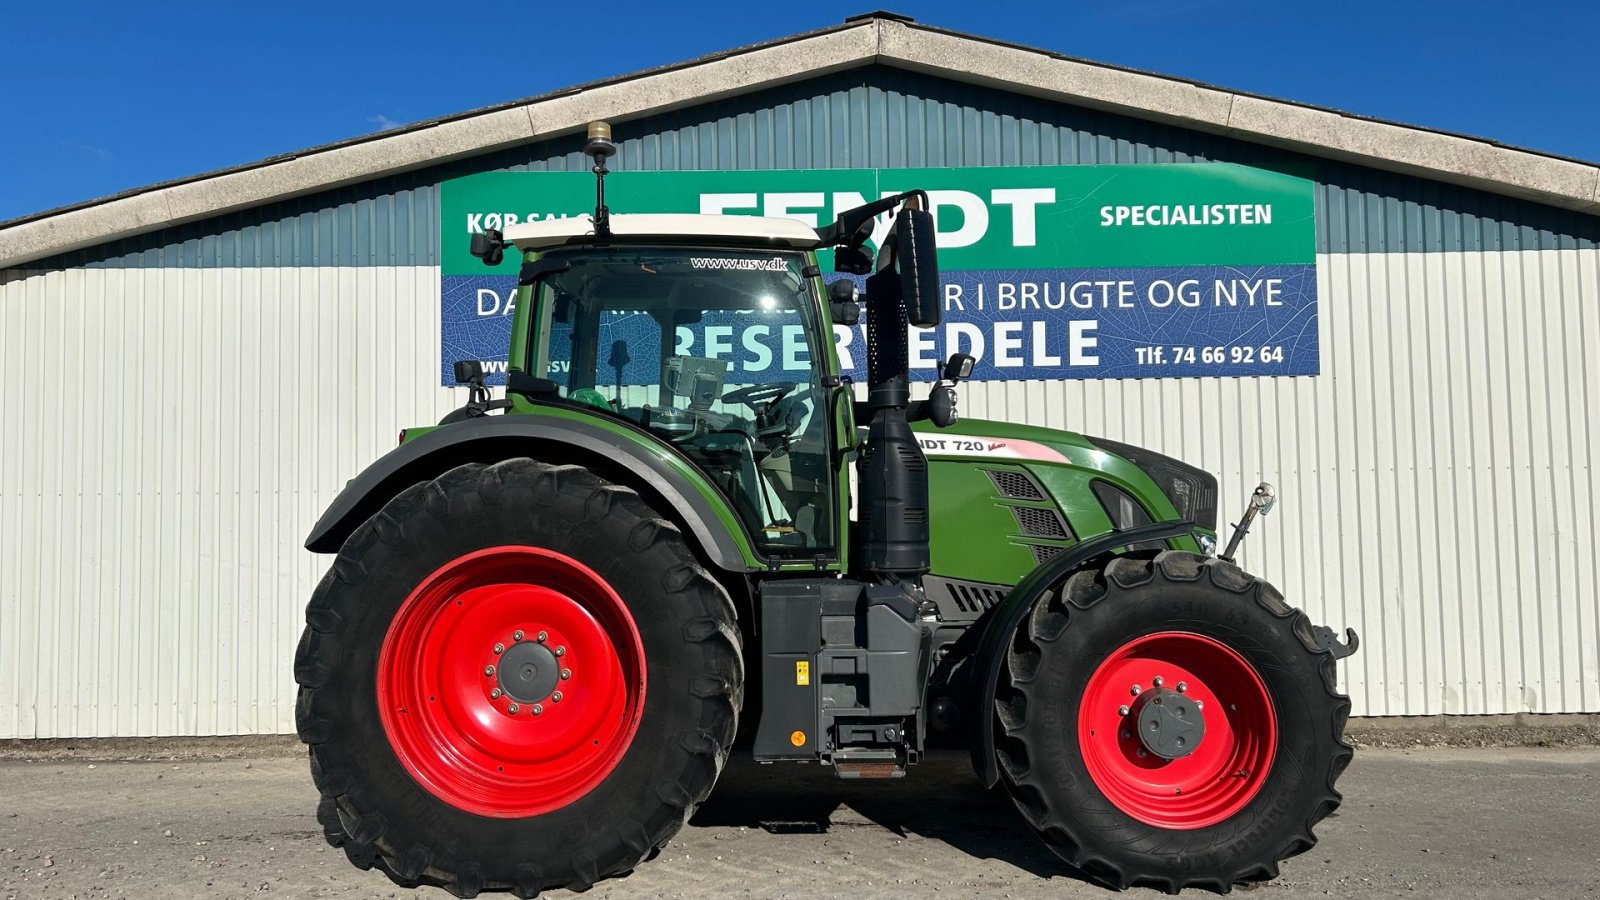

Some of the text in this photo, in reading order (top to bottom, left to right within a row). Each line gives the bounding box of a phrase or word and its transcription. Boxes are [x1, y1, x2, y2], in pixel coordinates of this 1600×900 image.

[1100, 205, 1272, 226] SPECIALISTEN
[690, 257, 788, 271] www.usv.dk
[999, 281, 1135, 310] BRUGTE
[1148, 279, 1200, 308] OG
[1215, 279, 1283, 307] NYE
[675, 320, 1100, 372] ESEREDELE
[1135, 346, 1283, 365] Tlf. 74 66 92 64
[953, 441, 984, 451] 720
